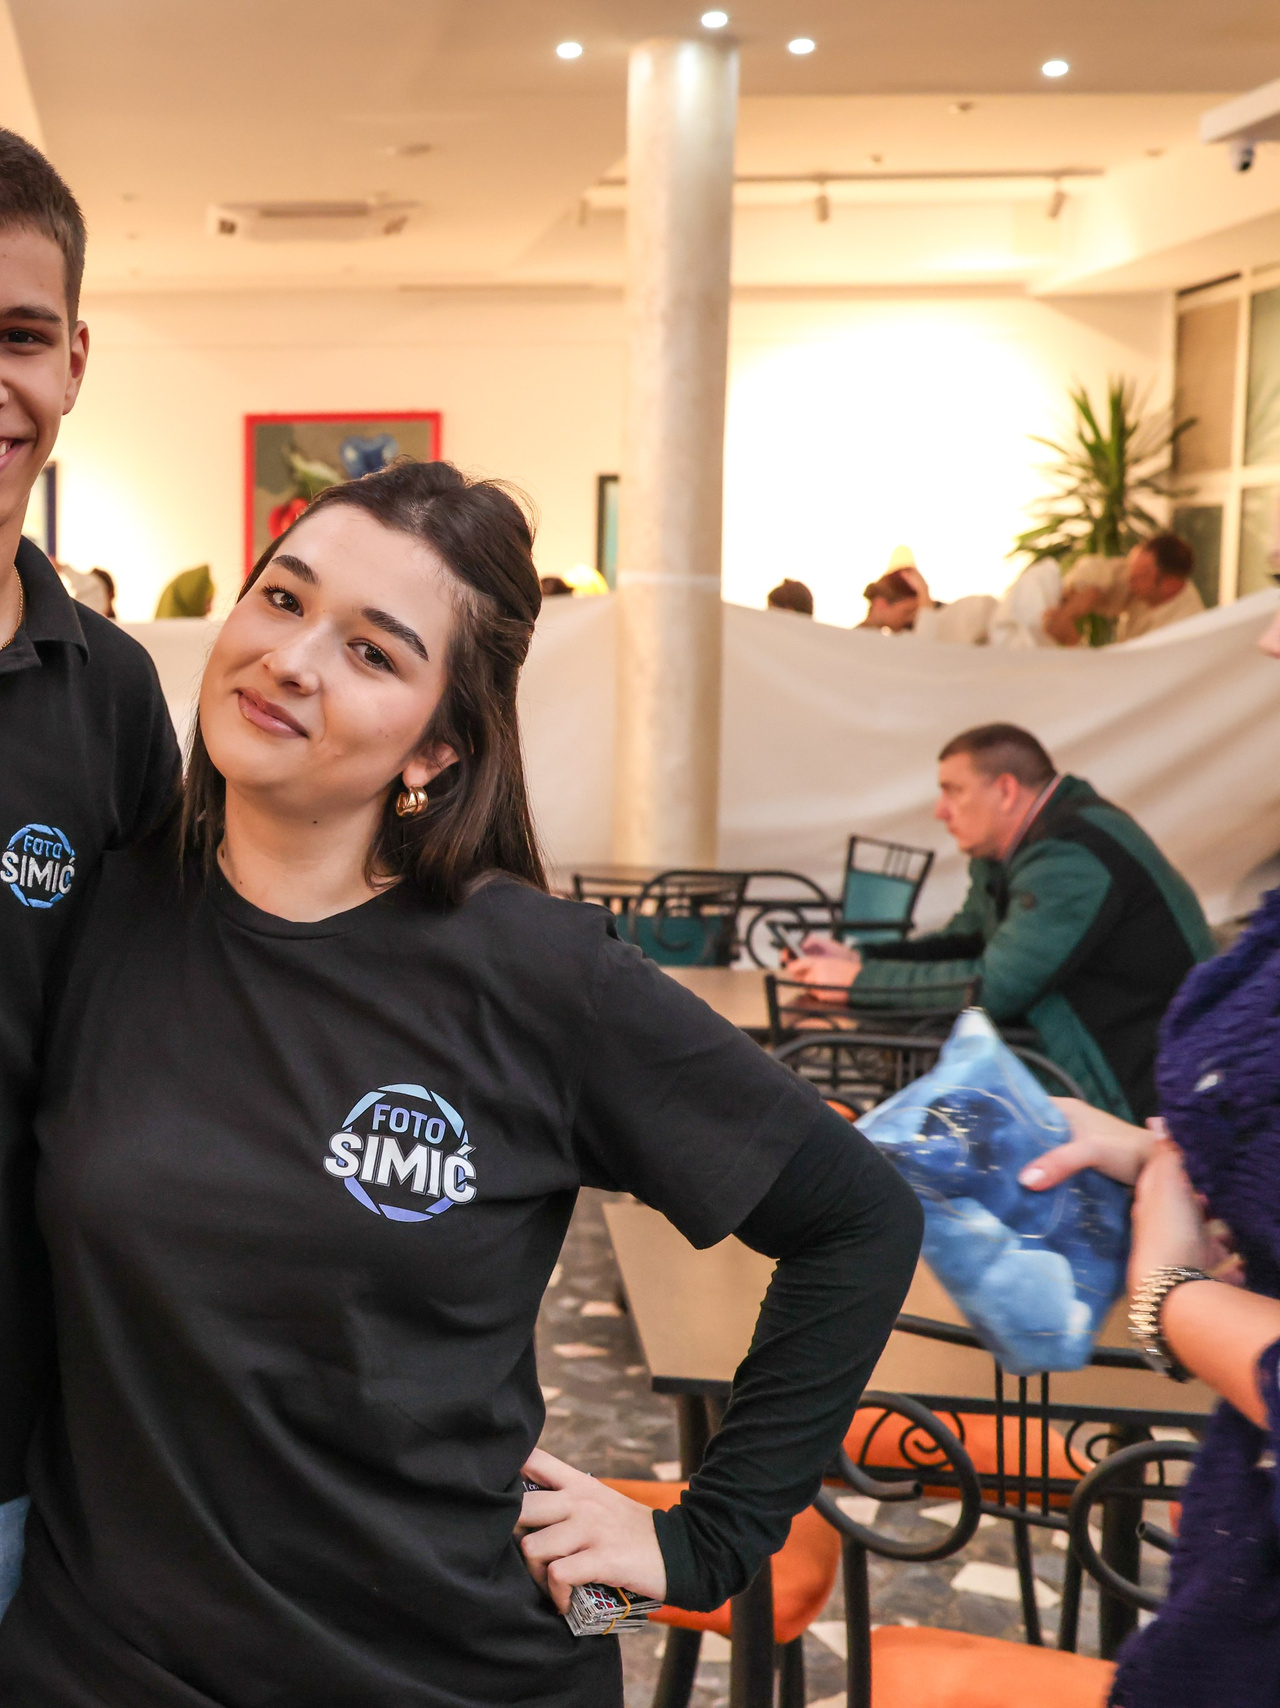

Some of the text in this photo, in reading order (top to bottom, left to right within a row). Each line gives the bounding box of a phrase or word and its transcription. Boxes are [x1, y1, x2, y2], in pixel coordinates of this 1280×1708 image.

[23, 834, 62, 859] FOTO
[0, 850, 75, 894] SIMIĆ
[372, 1103, 446, 1144] FOTO
[323, 1131, 477, 1204] SIMIĆ
